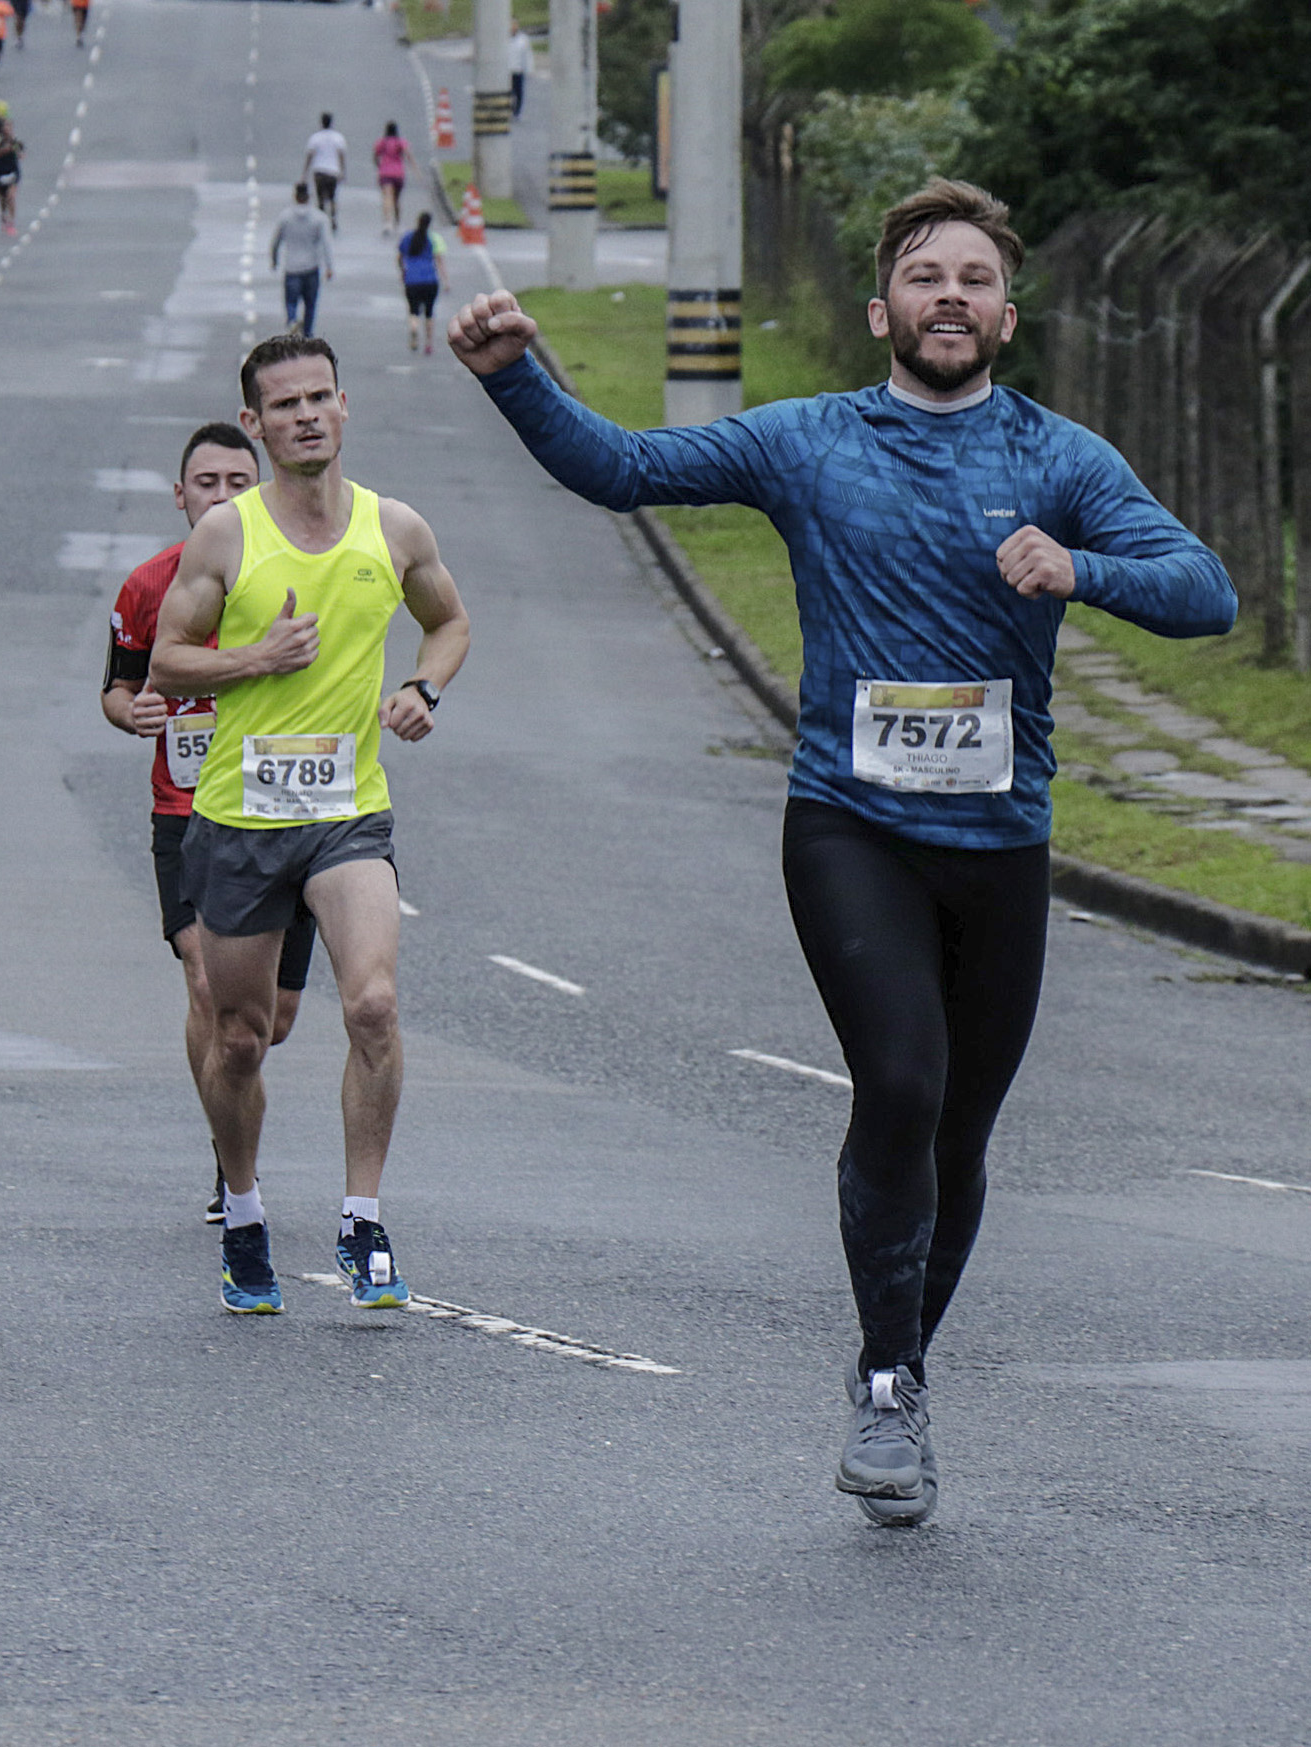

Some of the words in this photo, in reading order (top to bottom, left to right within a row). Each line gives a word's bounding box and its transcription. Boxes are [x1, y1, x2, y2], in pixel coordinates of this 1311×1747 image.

[873, 714, 982, 749] 7572
[906, 753, 948, 764] THIAGO
[257, 759, 335, 786] 6789
